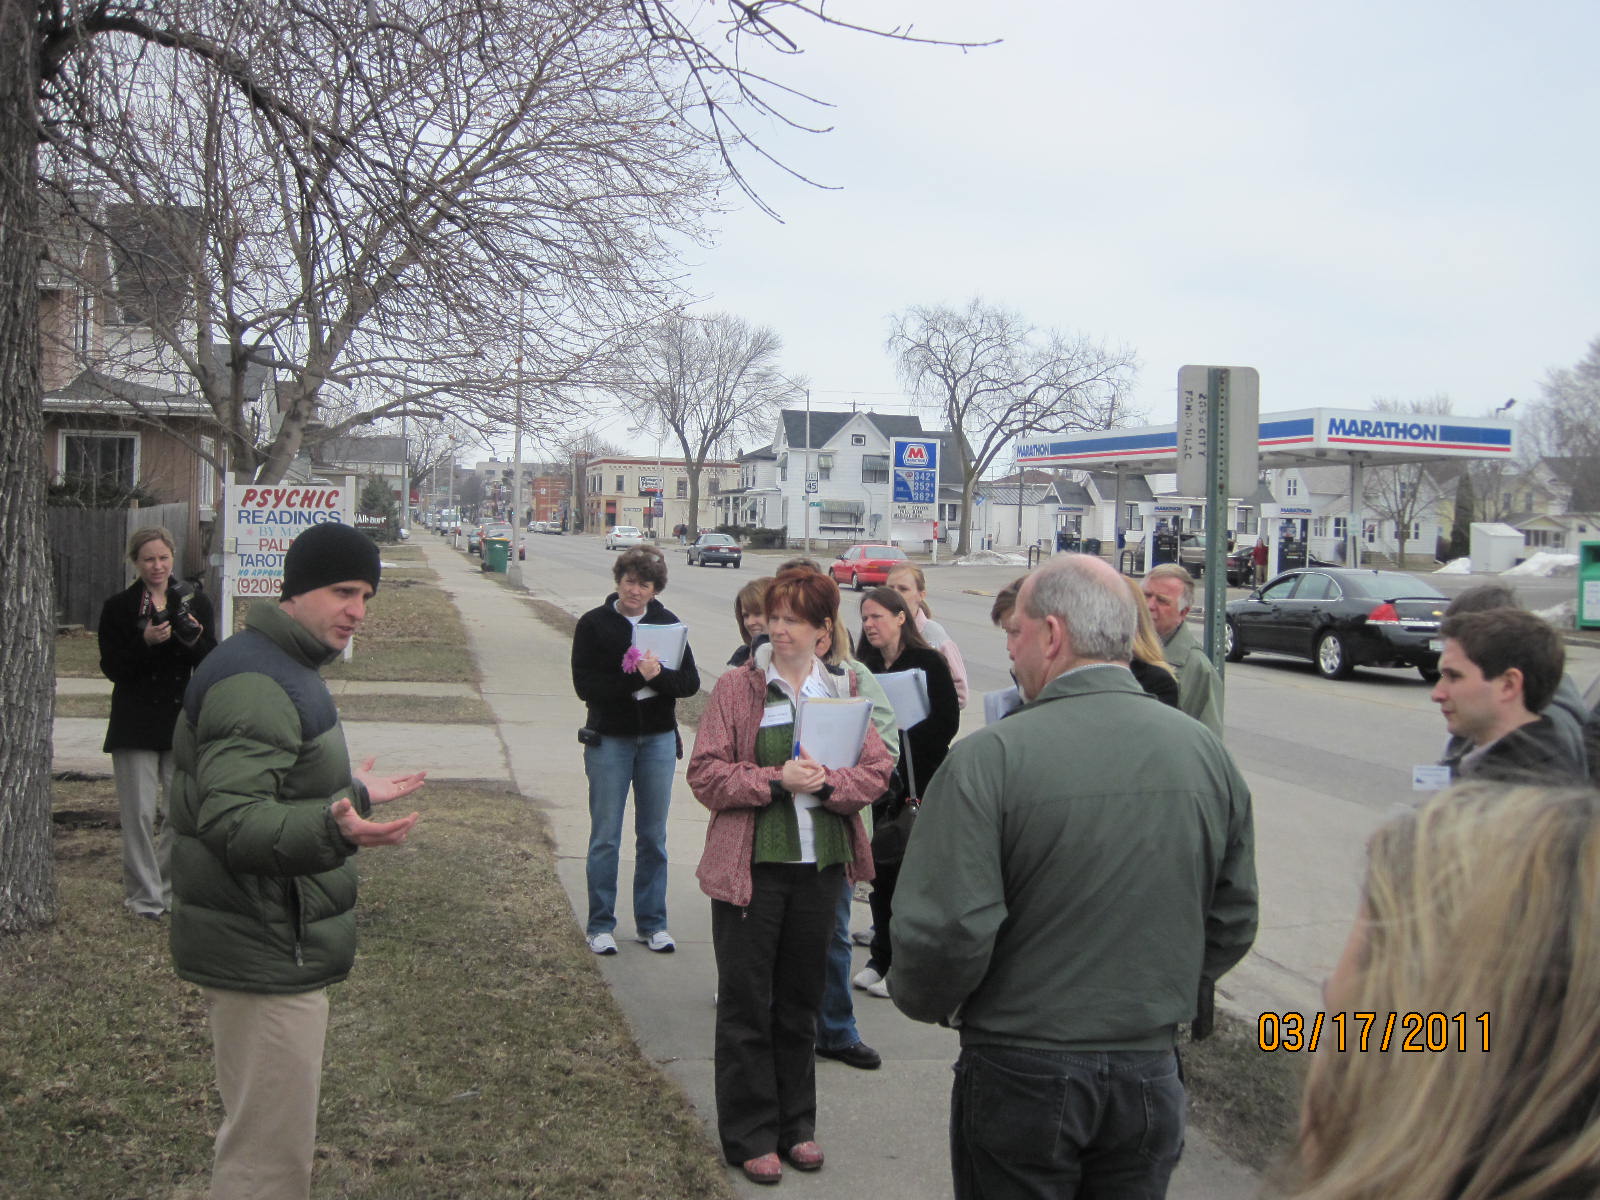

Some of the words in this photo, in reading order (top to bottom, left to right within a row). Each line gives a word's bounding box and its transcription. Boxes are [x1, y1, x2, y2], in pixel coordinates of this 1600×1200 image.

[1327, 418, 1438, 441] MARATHON
[1016, 444, 1049, 457] MARATHON
[1198, 428, 1207, 458] CITY
[908, 447, 925, 458] M
[807, 482, 817, 490] 45
[240, 488, 340, 509] PSYCHIC
[237, 510, 341, 525] READINGS
[259, 526, 275, 537] BY
[237, 553, 286, 568] TAROT
[238, 569, 250, 577] NO
[251, 569, 284, 577] APPOIN
[237, 577, 283, 595] (920)9
